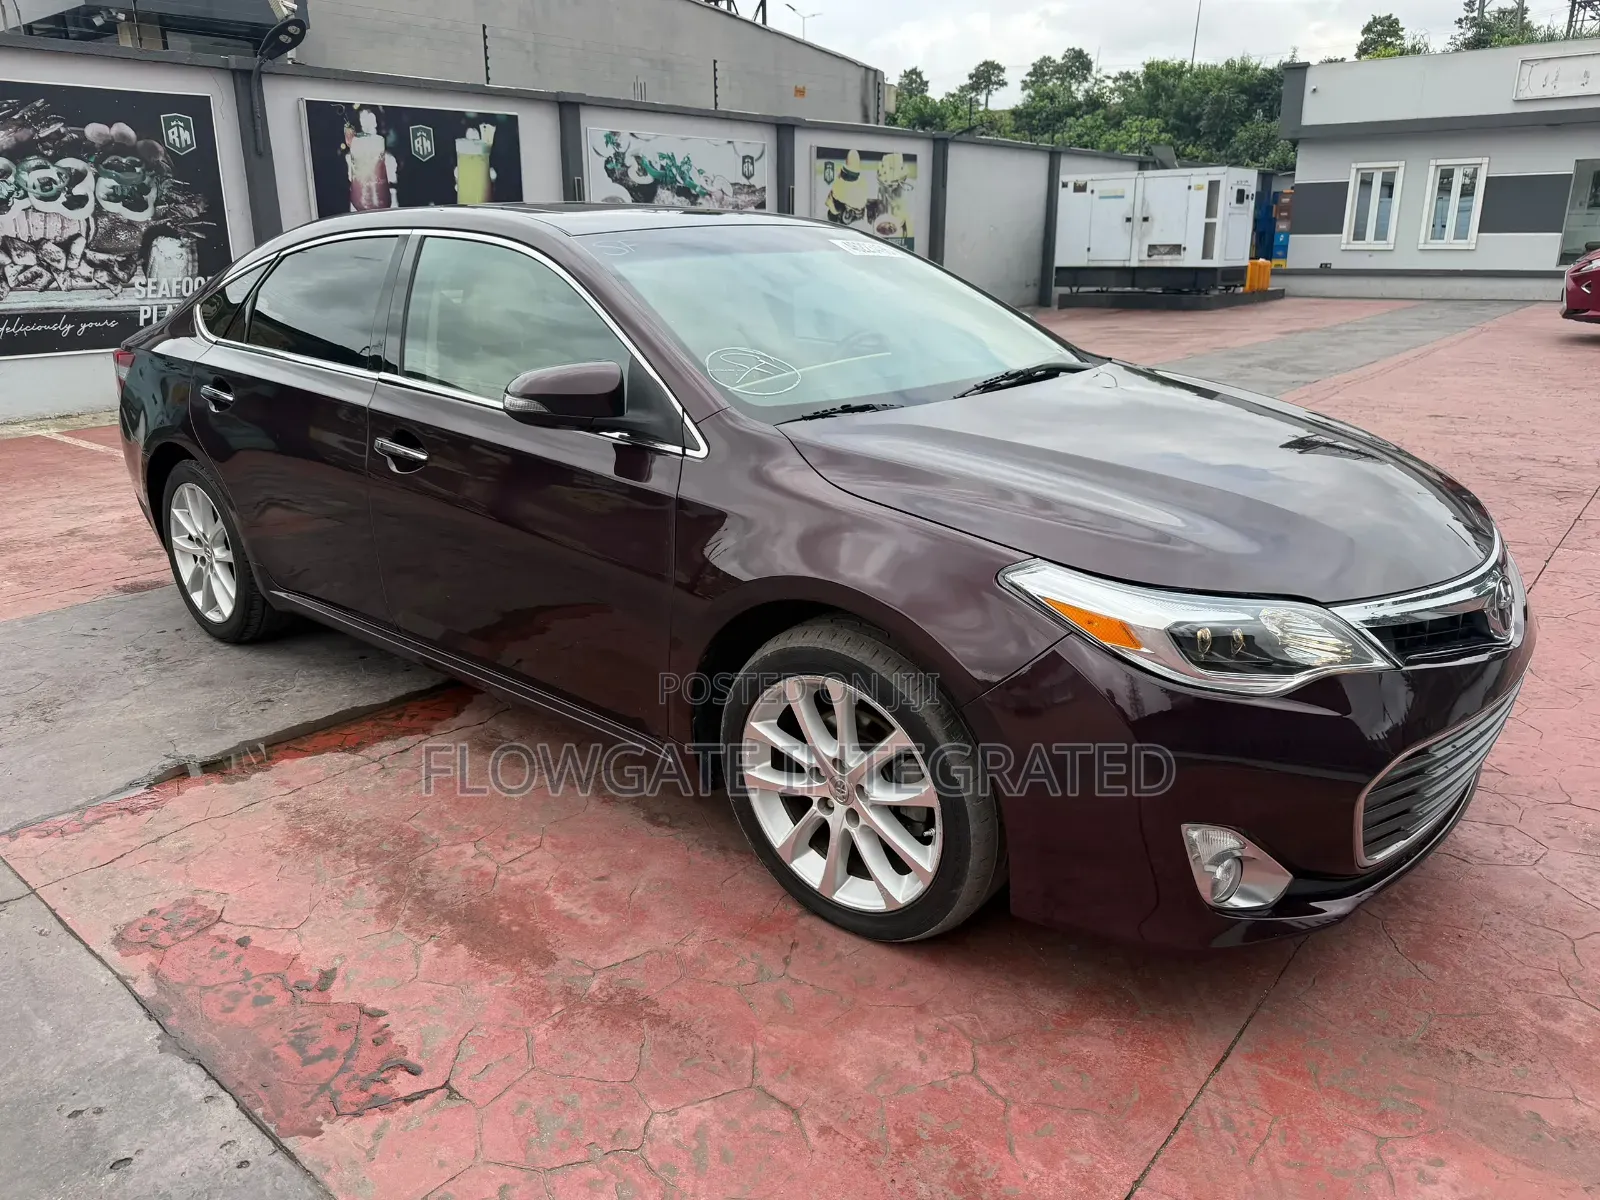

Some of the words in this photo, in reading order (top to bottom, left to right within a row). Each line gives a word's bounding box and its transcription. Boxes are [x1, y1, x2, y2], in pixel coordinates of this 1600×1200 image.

[167, 126, 192, 148] RM
[414, 136, 432, 155] RM
[134, 276, 213, 299] SEAFOO
[0, 314, 75, 340] deliciously
[76, 319, 119, 337] yours
[139, 304, 178, 327] PLA
